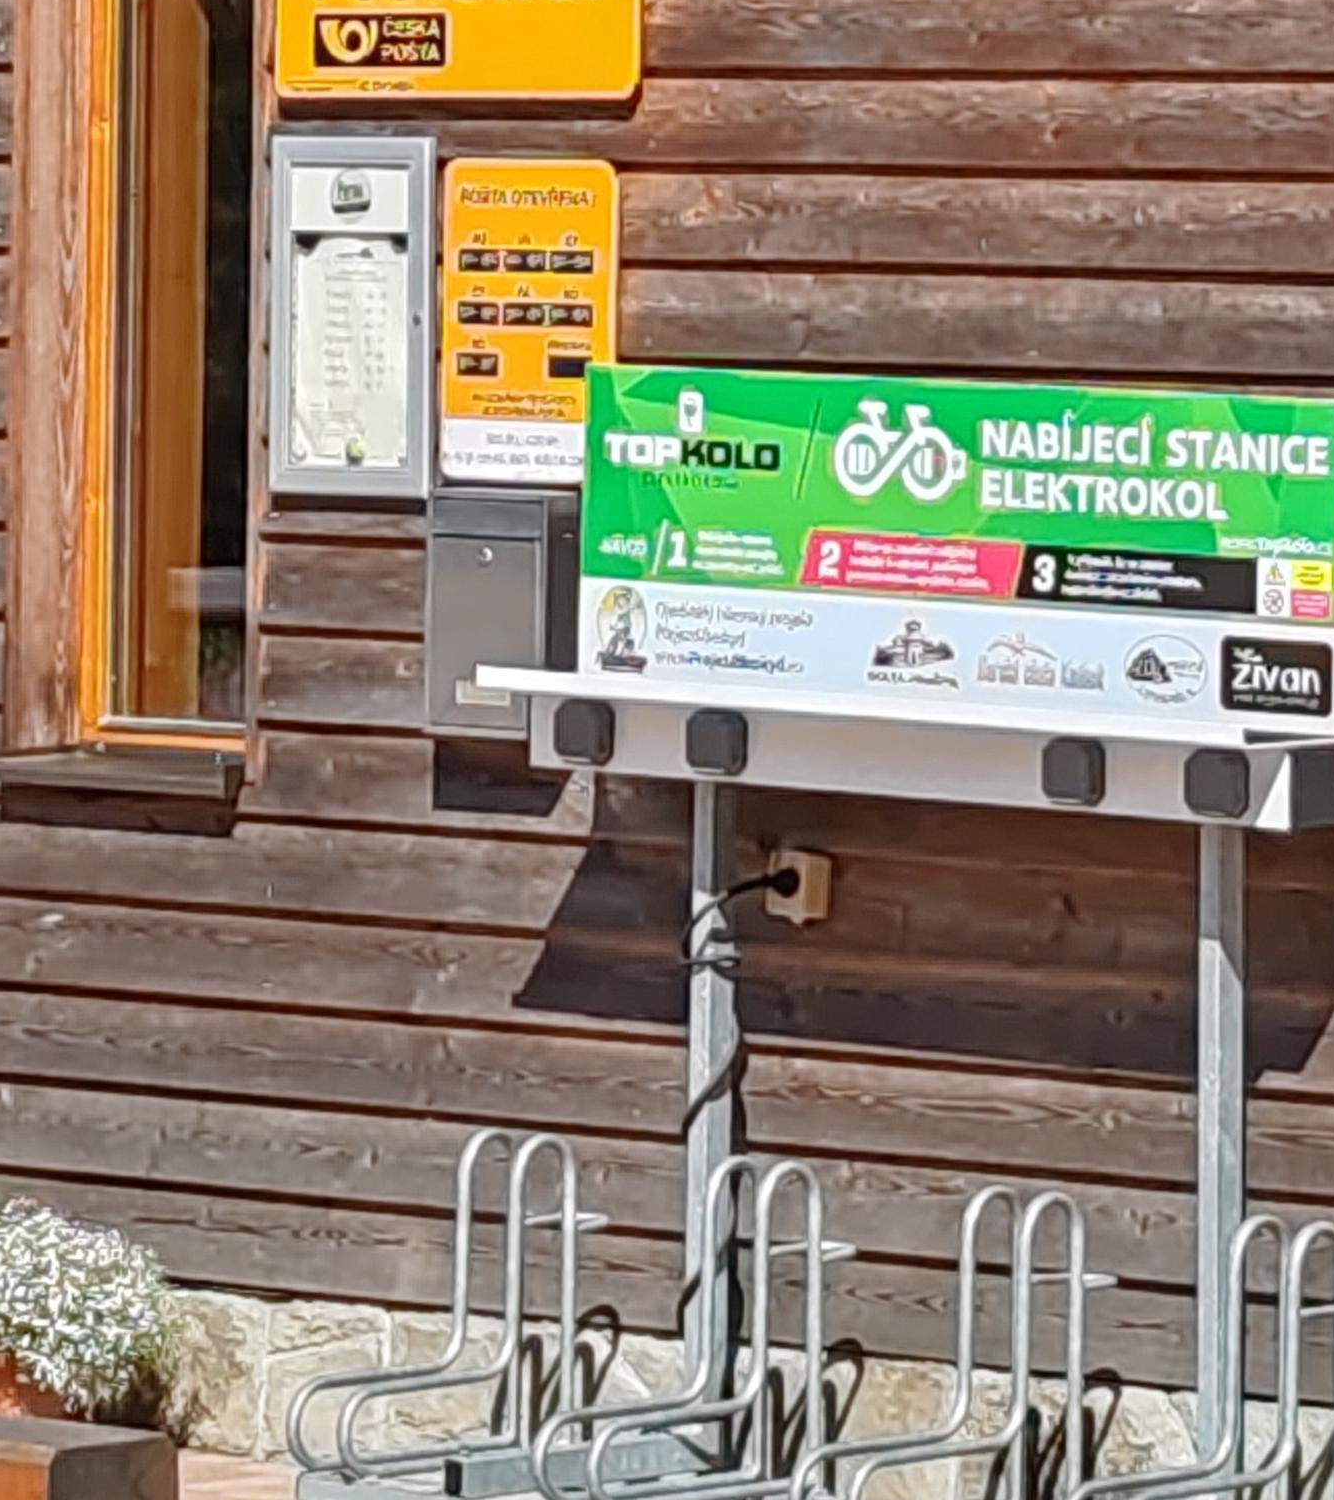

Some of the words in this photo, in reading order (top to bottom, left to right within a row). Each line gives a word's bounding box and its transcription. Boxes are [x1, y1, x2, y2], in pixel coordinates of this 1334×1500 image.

[604, 432, 780, 472] TOPKOLO
[980, 409, 1154, 467] NABÍJECÍ
[1165, 432, 1331, 476] STANICE
[980, 469, 1229, 521] ELEKTROKOL
[667, 531, 688, 567] 1
[818, 540, 842, 579] 2
[1032, 554, 1056, 592] 3
